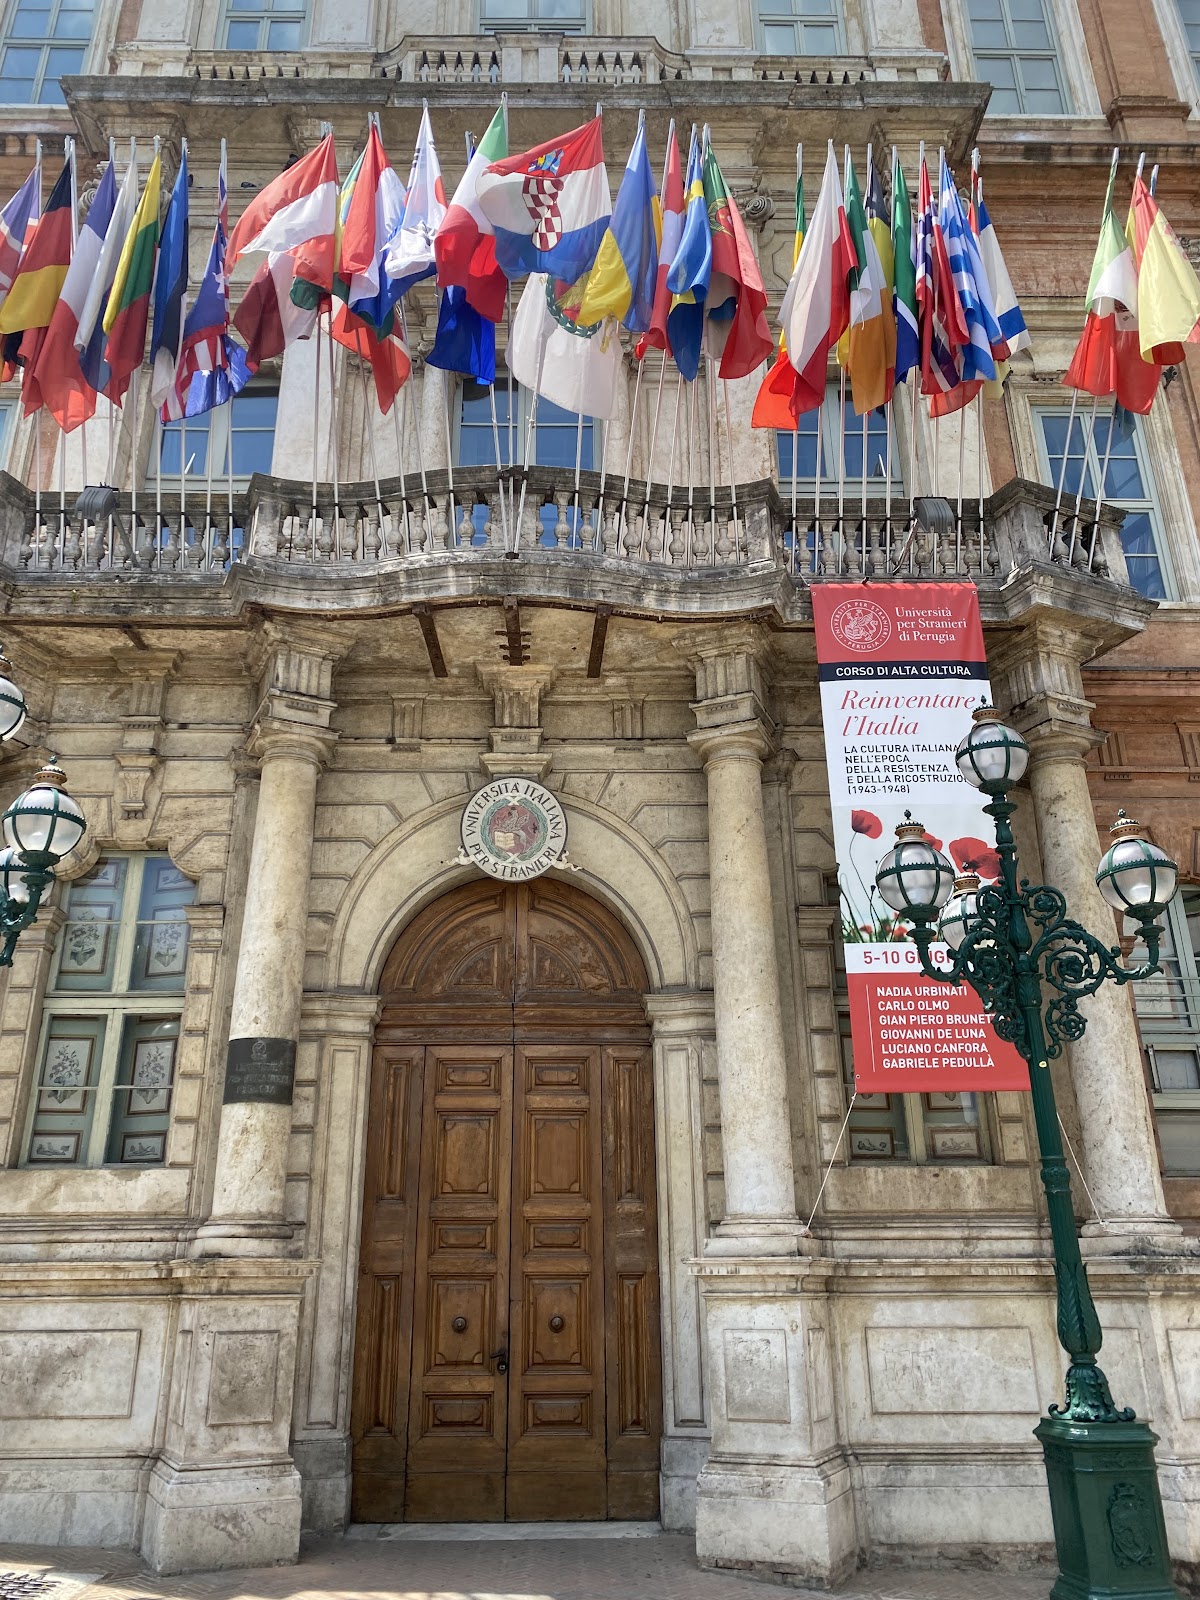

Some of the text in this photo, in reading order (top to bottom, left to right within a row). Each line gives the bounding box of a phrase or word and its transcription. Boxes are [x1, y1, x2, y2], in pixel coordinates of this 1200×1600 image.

[895, 607, 952, 617] Università
[897, 618, 967, 631] per Stranieri
[899, 631, 956, 645] di Perugia
[847, 641, 880, 650] PERUGIA
[836, 665, 972, 676] CORSO DI ALTA CULTURA
[839, 689, 976, 710] Reinventare
[842, 714, 919, 737] l'Italia
[844, 745, 858, 754] LA
[860, 744, 910, 753] CULTURA
[845, 754, 910, 764] NELL'EPOCA
[846, 764, 950, 774] DELLA RESISTENZA
[847, 774, 968, 784] E DELLA RICOSTRUZIO
[848, 784, 910, 795] (1943-1948)
[524, 784, 563, 840] ITALIANA
[469, 842, 558, 878] PER STRANIERI
[863, 950, 900, 965] 5-10
[876, 986, 968, 997] NADIA URBINATI
[878, 1000, 950, 1011] CARLO OLMO
[879, 1015, 907, 1025] GIAN
[909, 1014, 946, 1025] PIERO
[880, 1028, 987, 1039] GIOVANNI DE LUNA
[881, 1043, 989, 1054] LUCIANO CANFORA
[882, 1054, 995, 1069] GABRIELE PEDULLÀ
